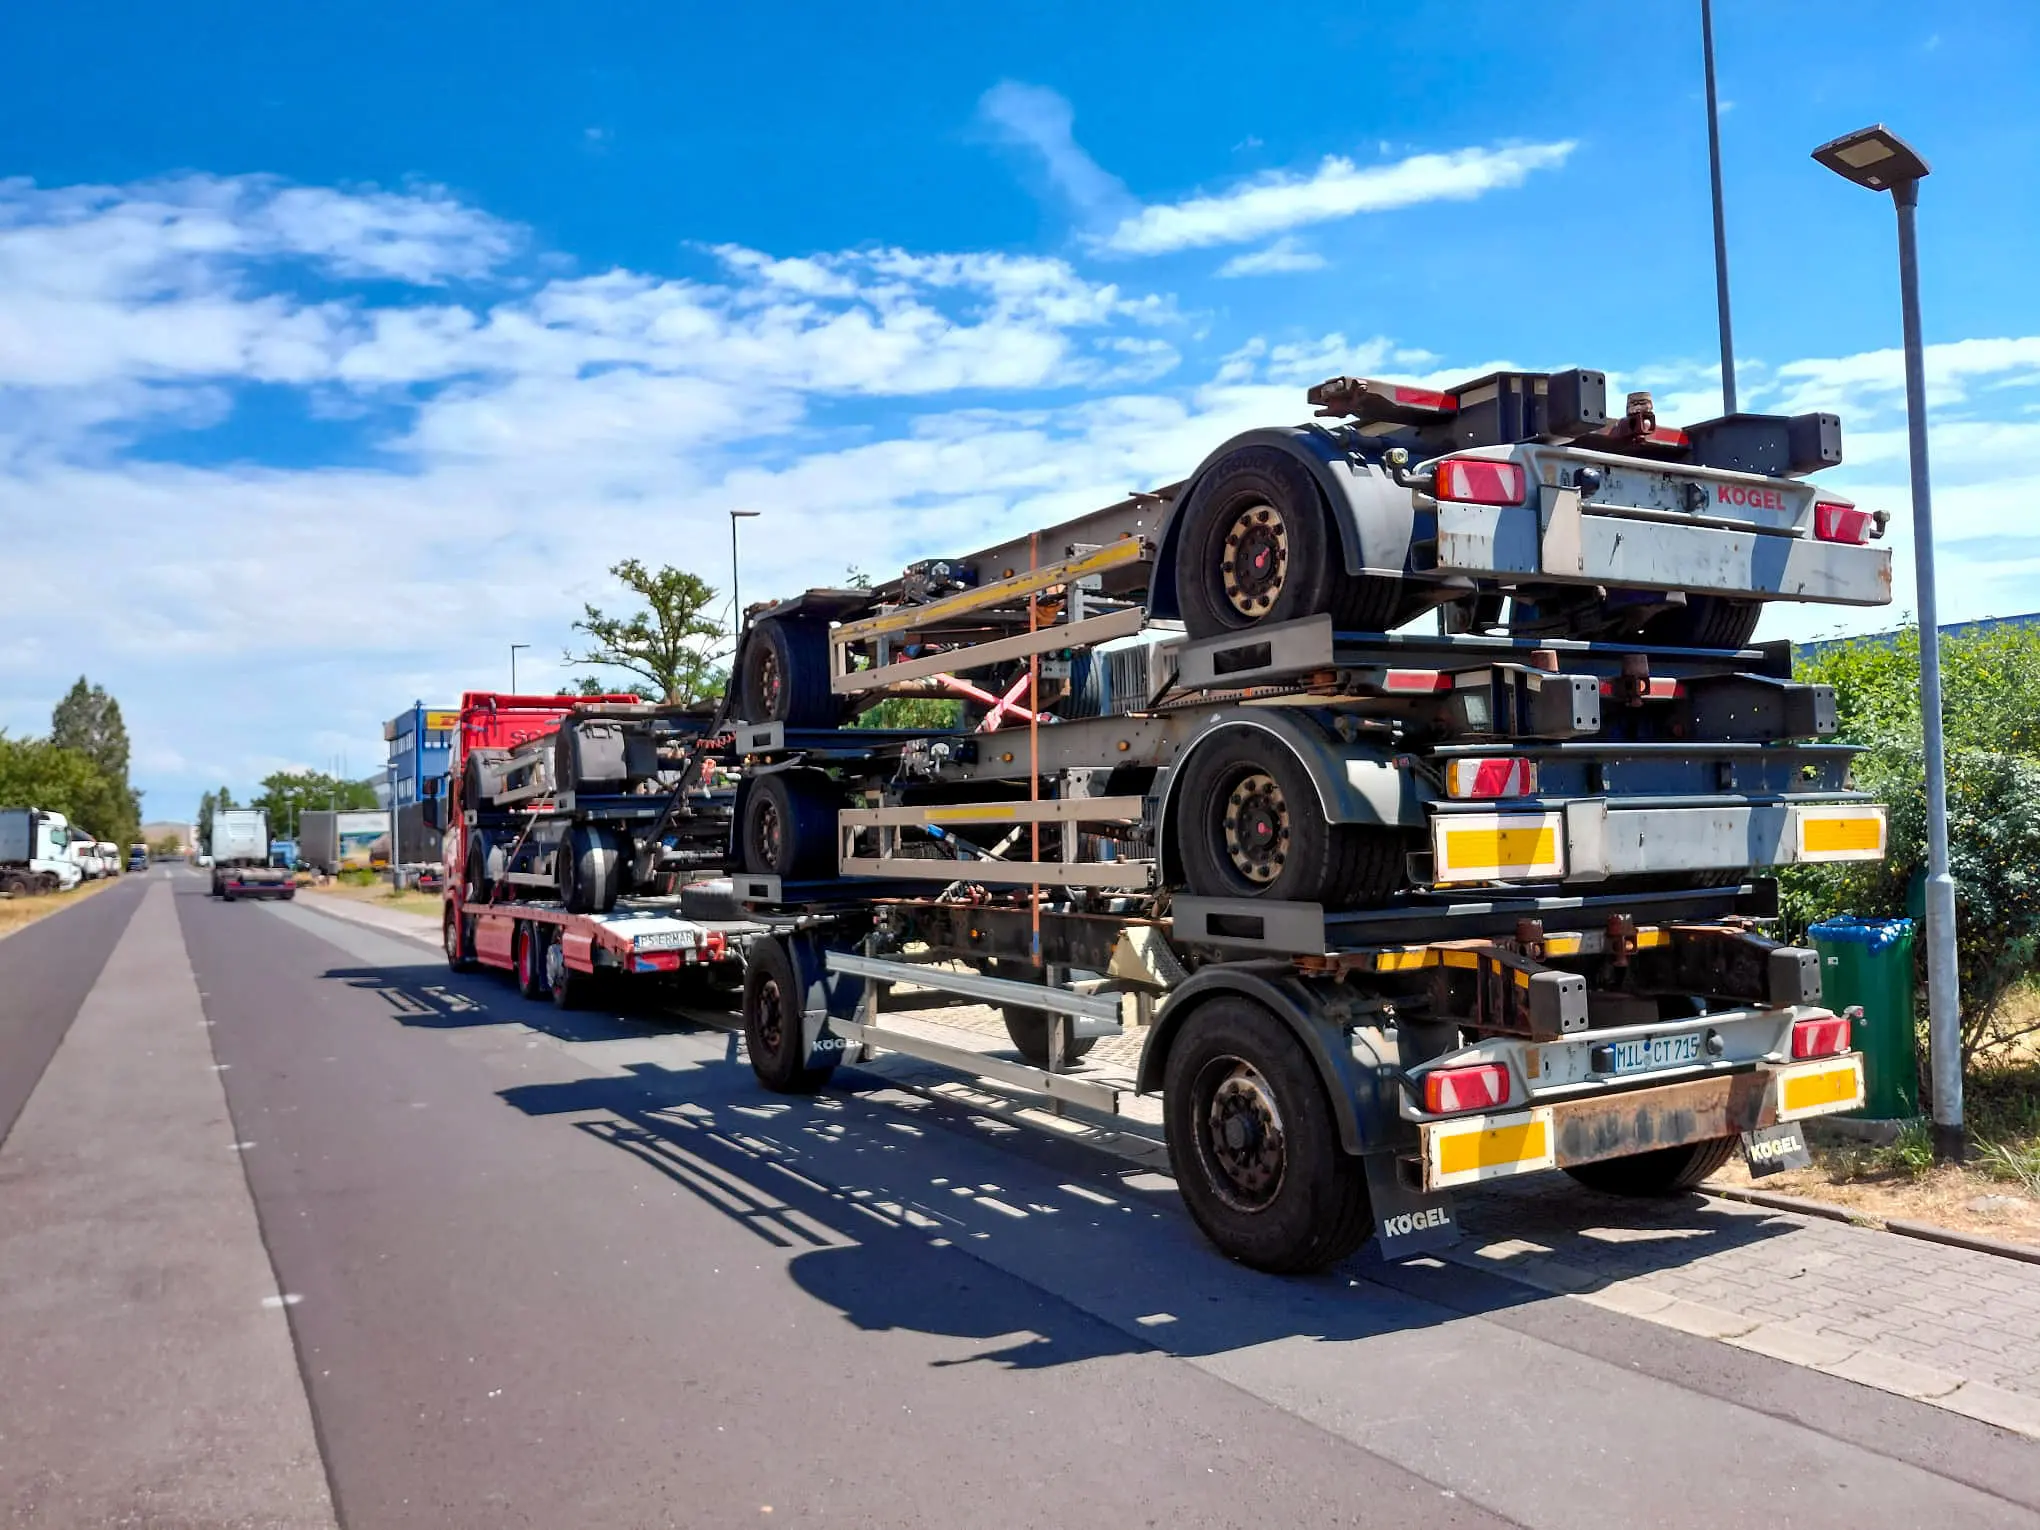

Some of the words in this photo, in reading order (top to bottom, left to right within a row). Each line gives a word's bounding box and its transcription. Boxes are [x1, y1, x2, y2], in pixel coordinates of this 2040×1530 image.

[1717, 484, 1786, 511] KÖGEL
[1617, 1043, 1642, 1068] MIL
[1654, 1040, 1670, 1062] CT
[1675, 1036, 1699, 1060] 715
[1751, 1135, 1801, 1161] KÖGEL
[1383, 1207, 1450, 1237] KÖGEL
